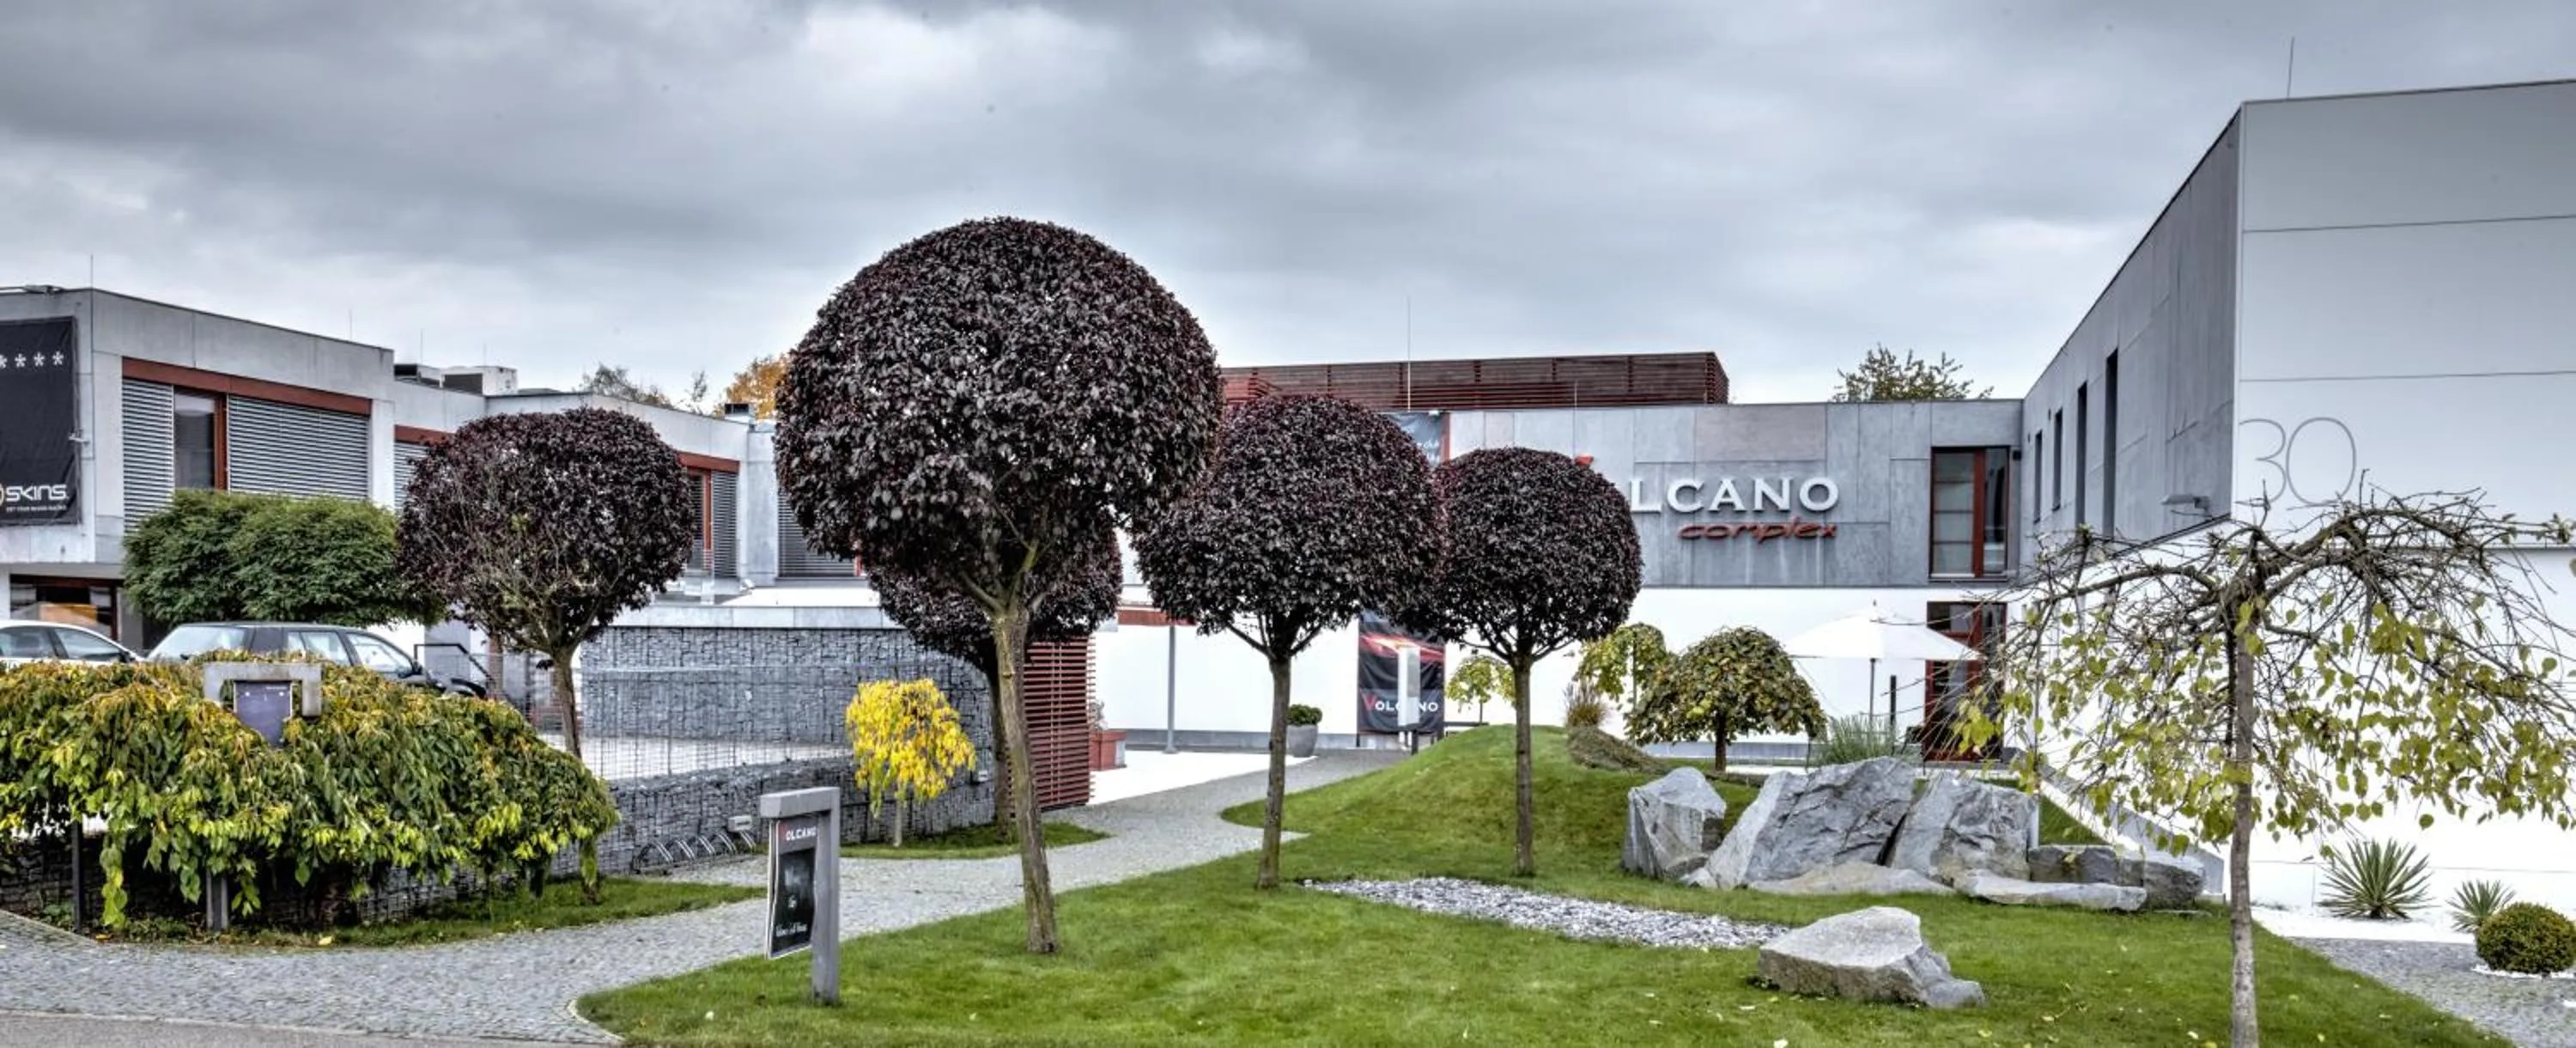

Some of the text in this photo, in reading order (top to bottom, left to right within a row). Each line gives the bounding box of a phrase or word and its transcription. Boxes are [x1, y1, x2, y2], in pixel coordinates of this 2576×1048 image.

[2235, 417, 2356, 506] 30
[1628, 475, 1839, 514] LCANO
[1677, 515, 1838, 545] complex
